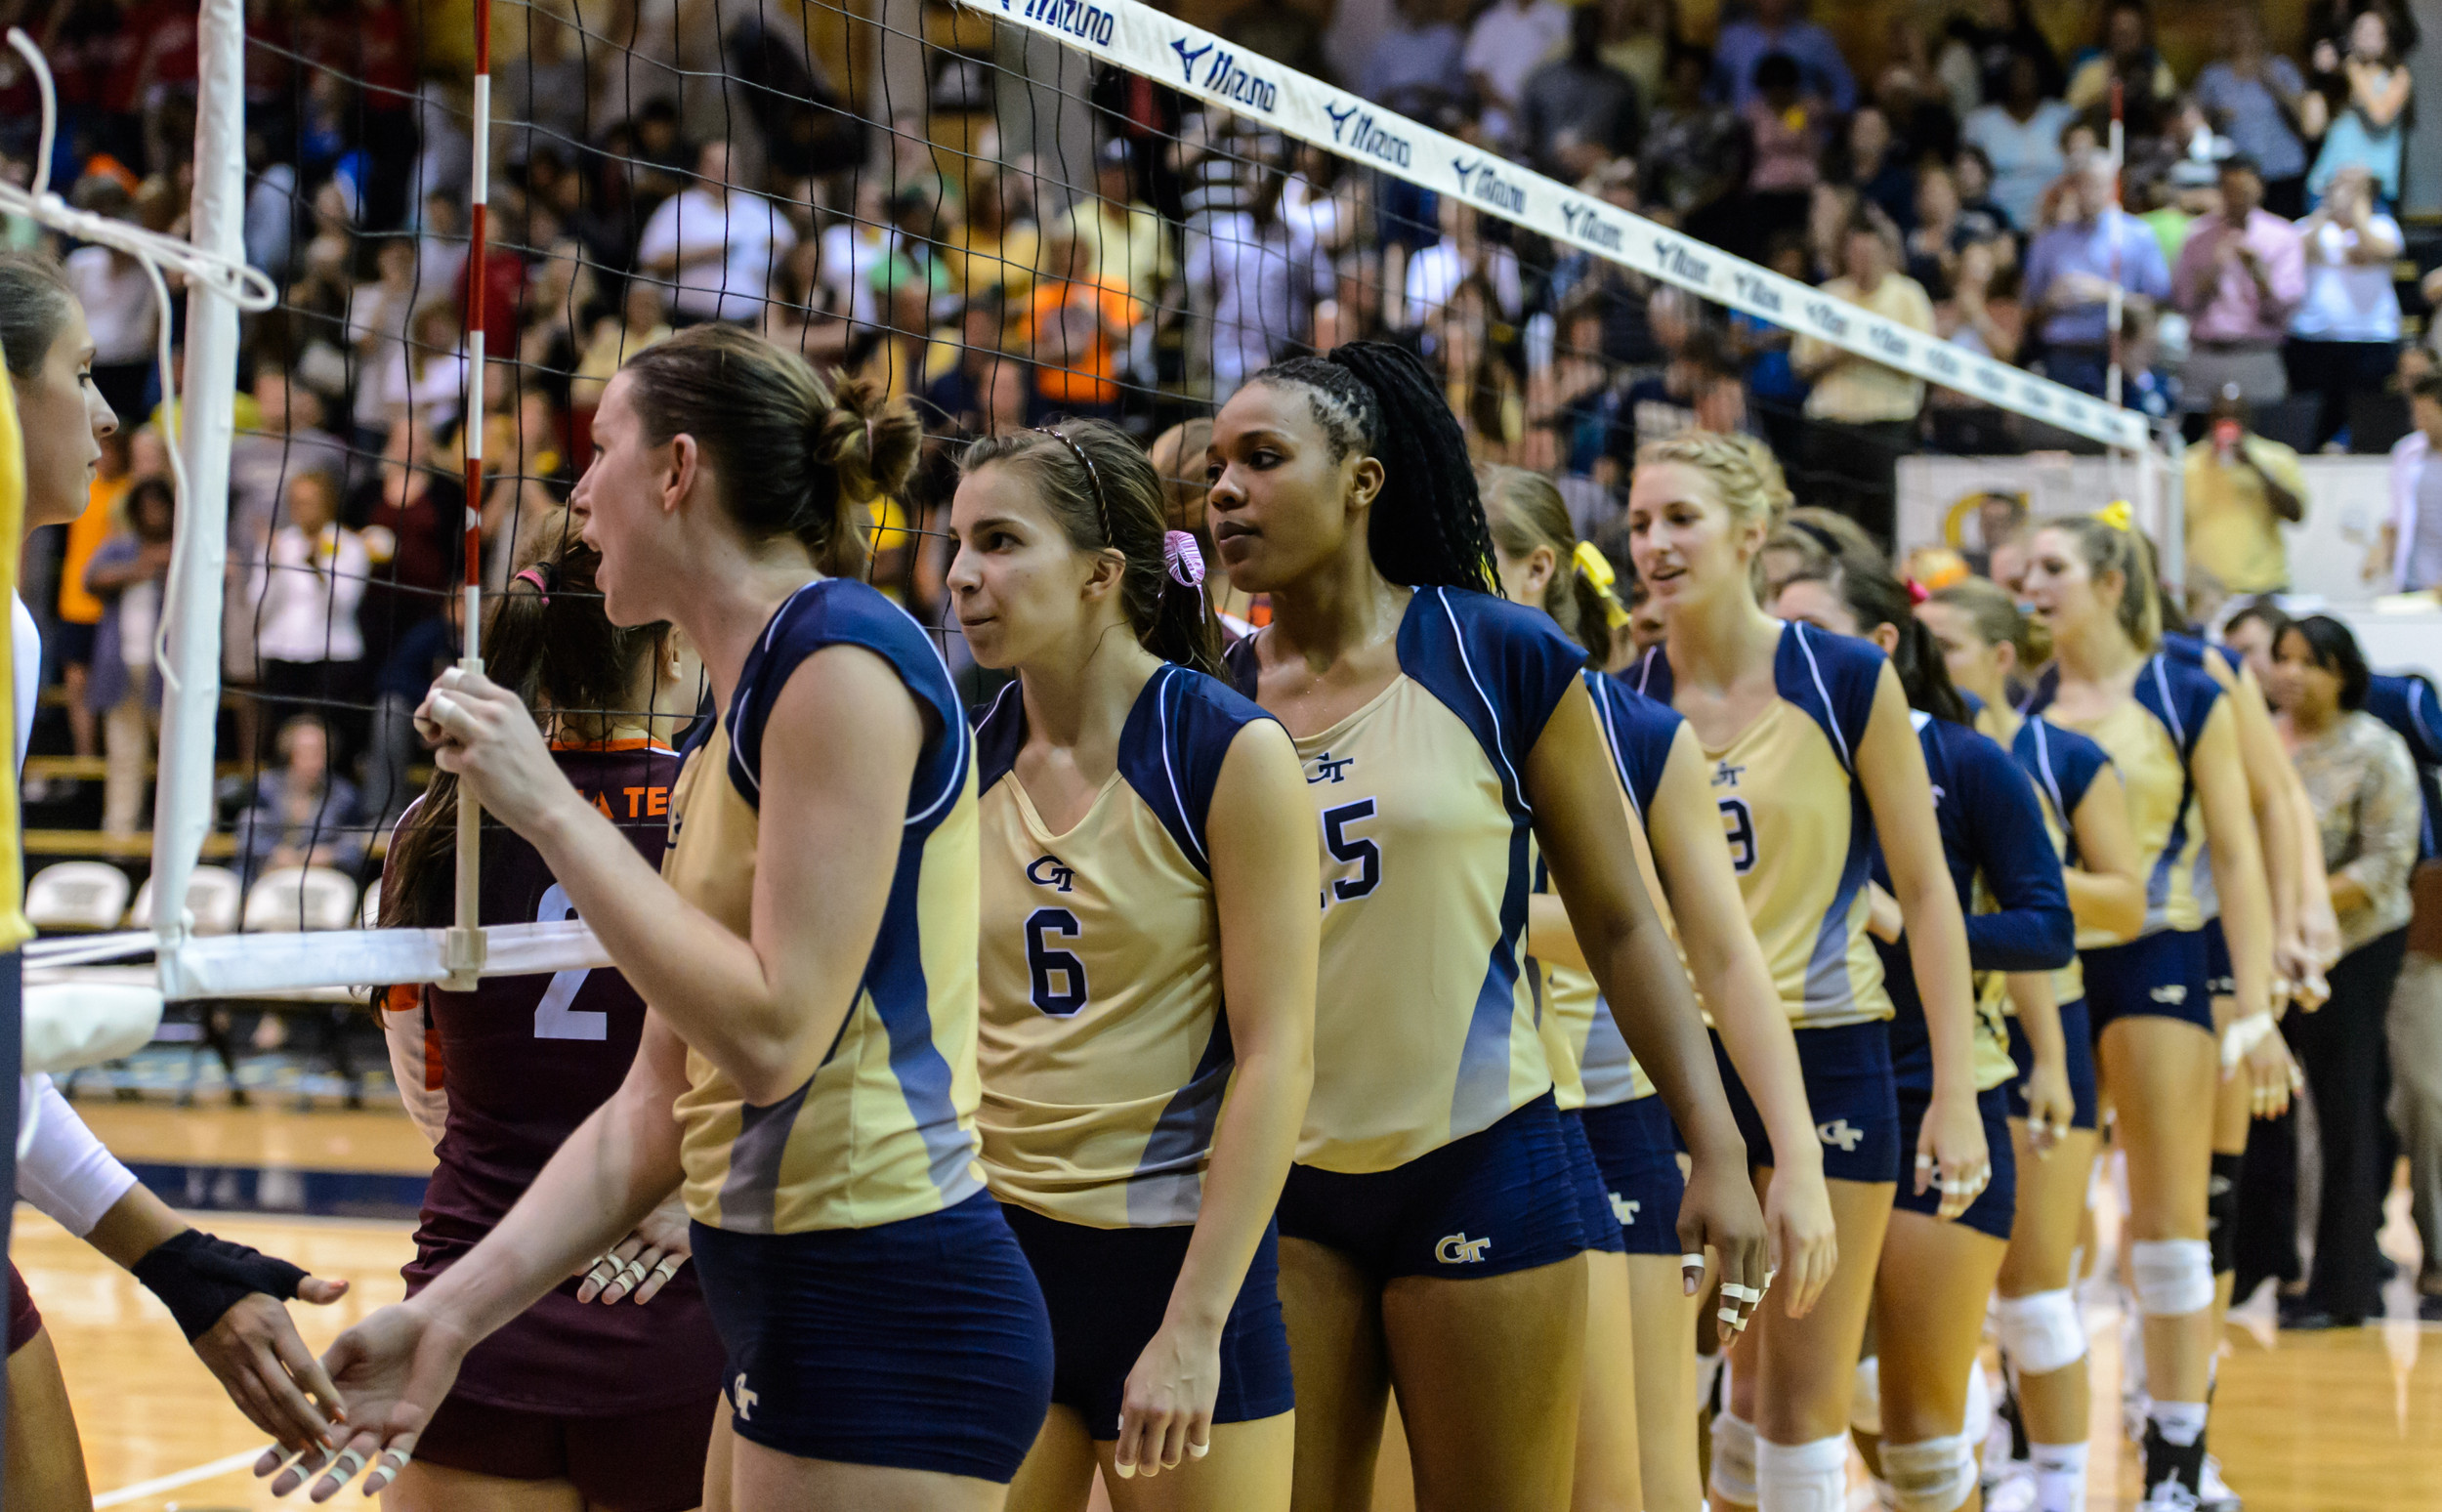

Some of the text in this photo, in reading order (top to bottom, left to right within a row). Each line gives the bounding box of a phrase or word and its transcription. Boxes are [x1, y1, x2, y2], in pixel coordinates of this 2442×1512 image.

[1203, 50, 1277, 112] Mizuno
[1321, 795, 1382, 909] 5
[1024, 905, 1089, 1017] 6
[1435, 1232, 1491, 1264] GT
